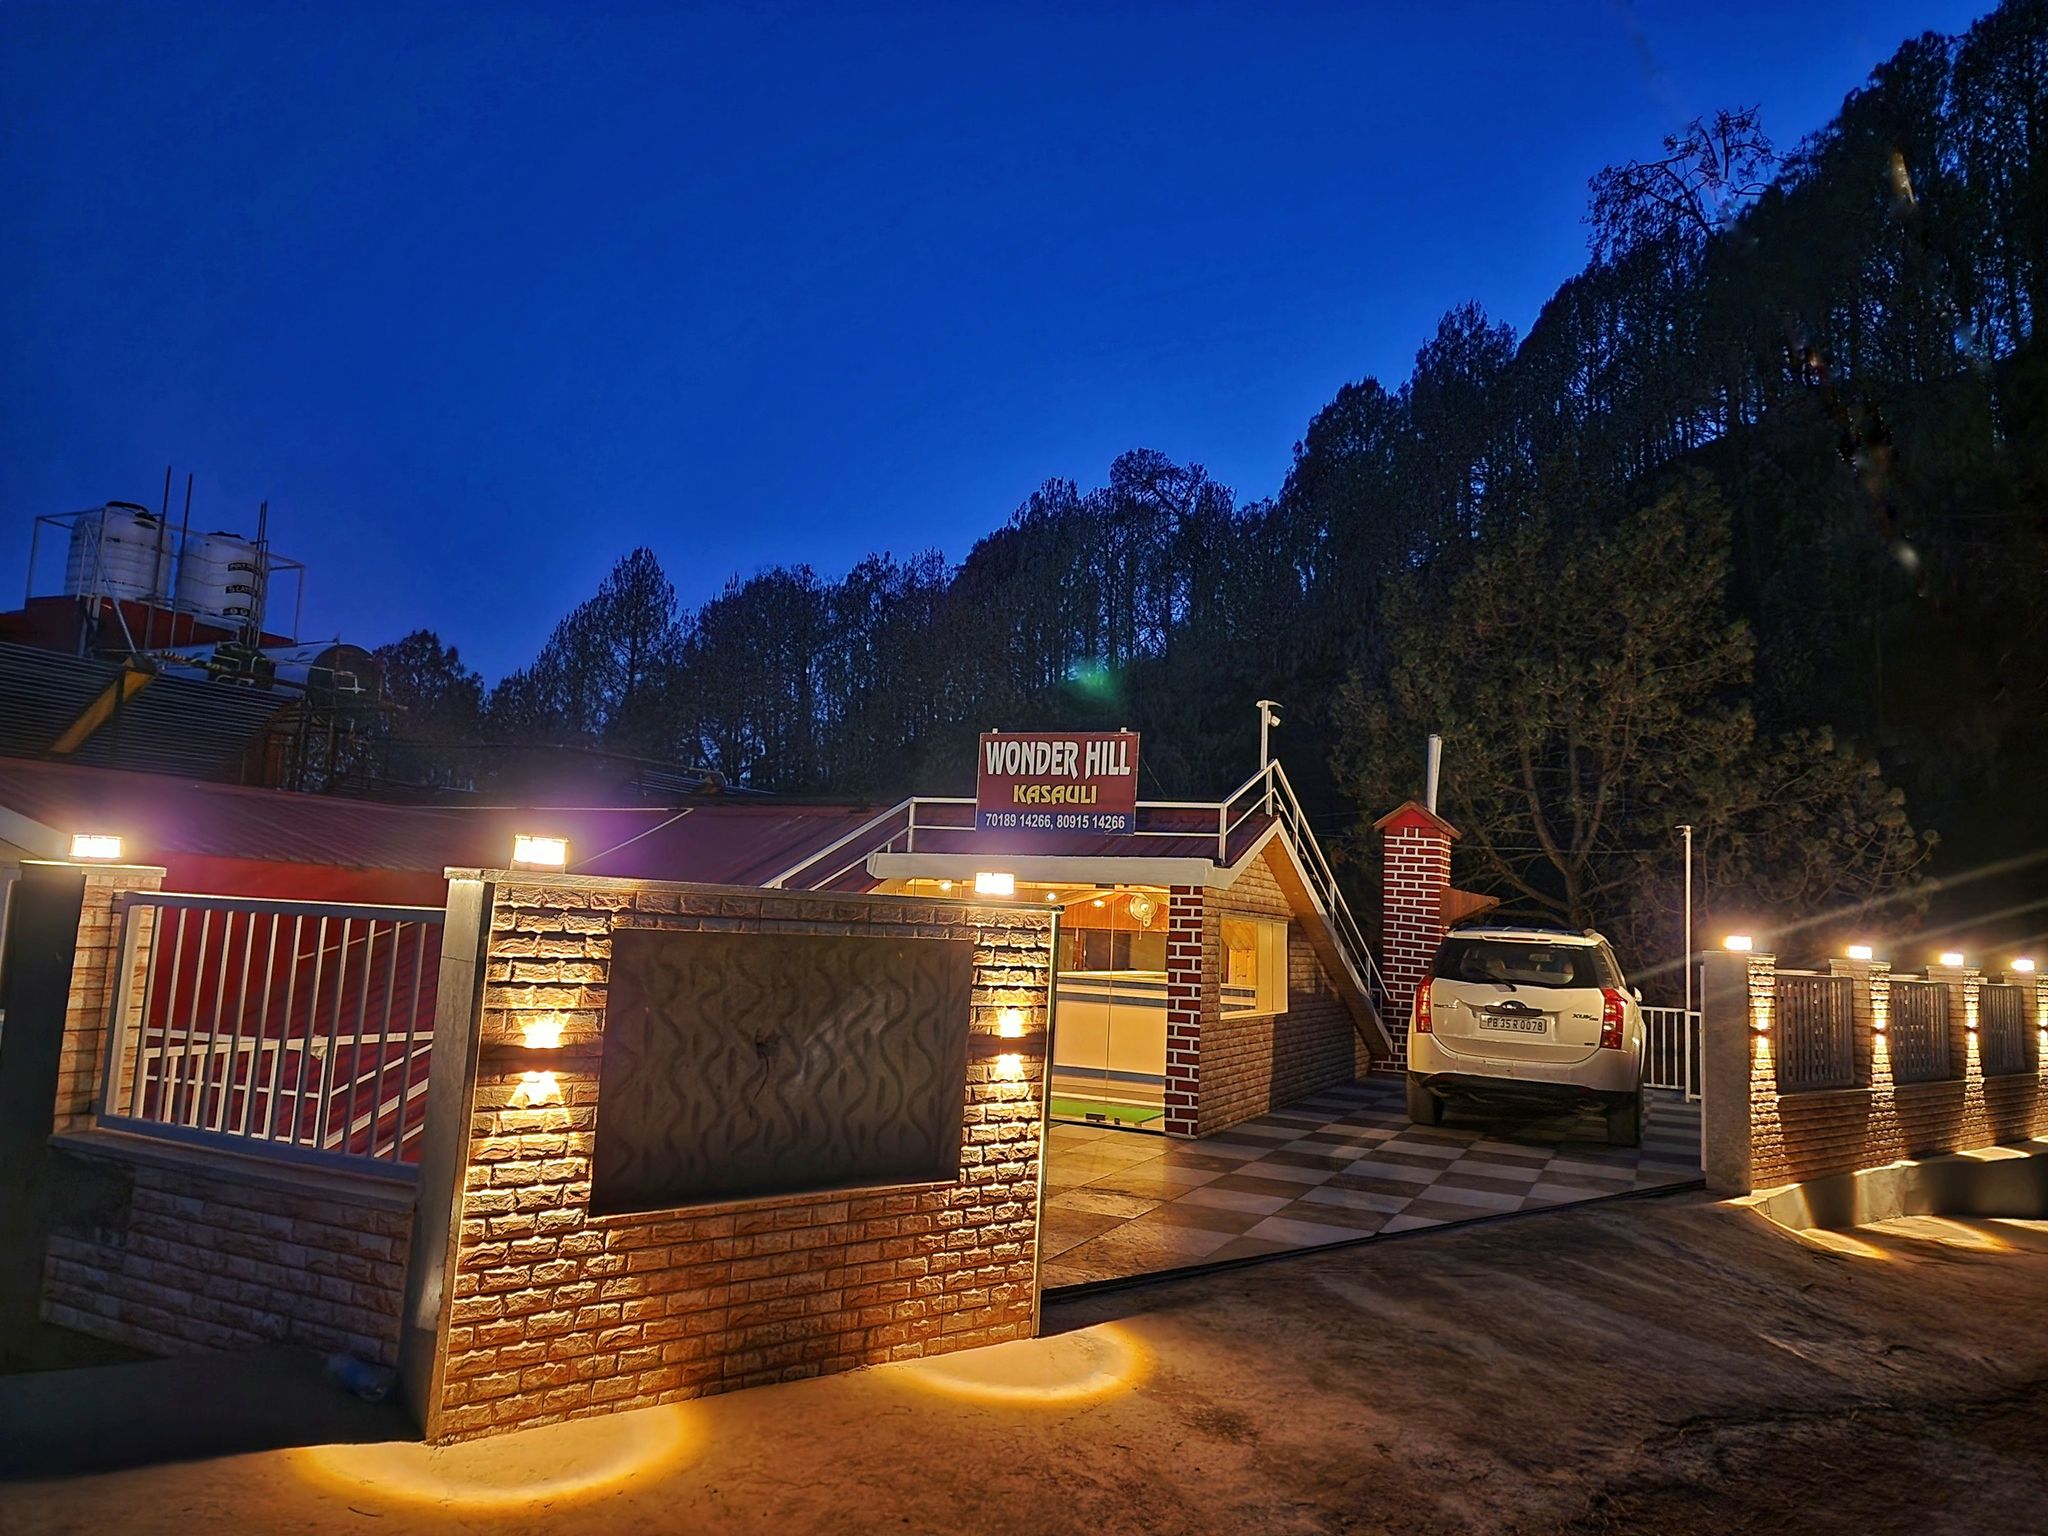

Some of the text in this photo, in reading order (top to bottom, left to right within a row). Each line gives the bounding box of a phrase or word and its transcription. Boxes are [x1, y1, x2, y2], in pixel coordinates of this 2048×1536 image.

[985, 741, 1131, 780] WONDER HILL
[1013, 784, 1098, 805] KASAULI
[985, 813, 1126, 830] 70189 14266, 80915 14266
[1487, 1017, 1543, 1031] PB 35 R 0078
